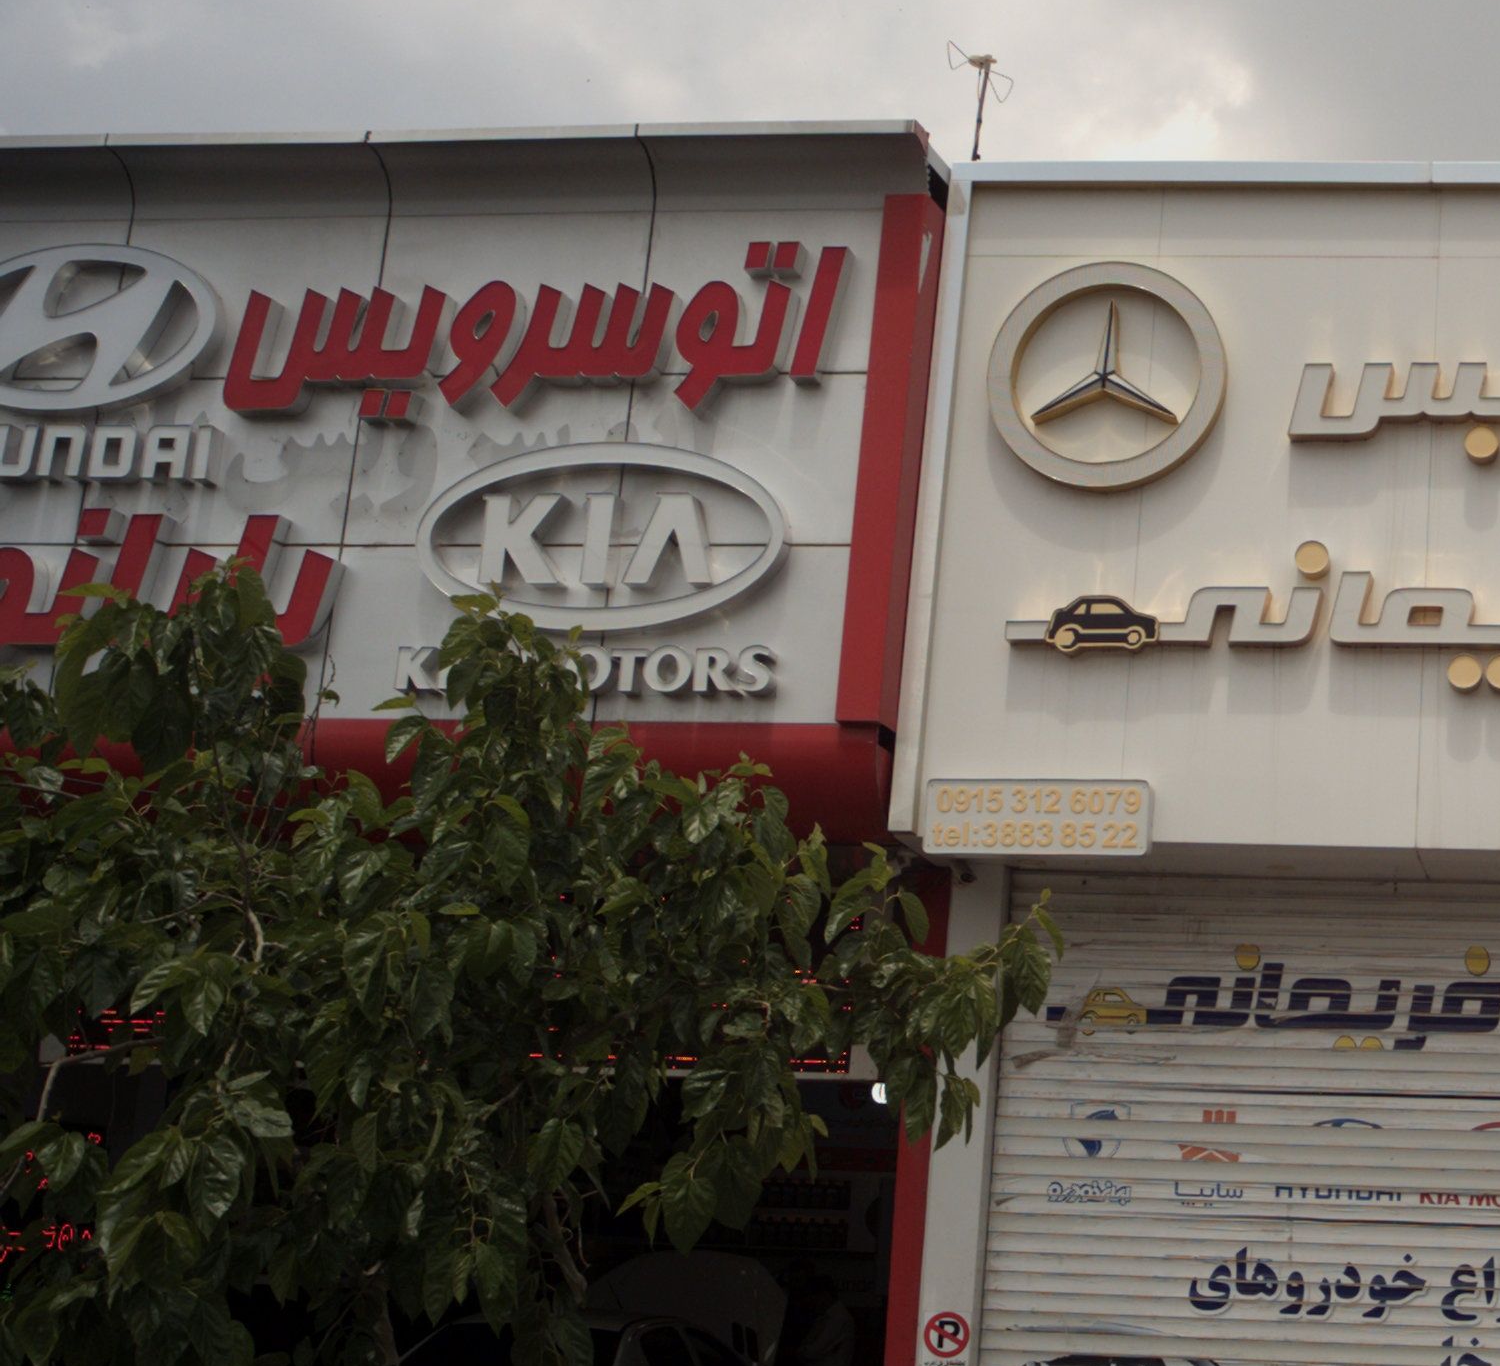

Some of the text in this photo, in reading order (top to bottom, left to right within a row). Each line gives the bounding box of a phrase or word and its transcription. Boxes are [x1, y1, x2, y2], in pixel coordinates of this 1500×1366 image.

[477, 491, 714, 588] KIA
[508, 644, 778, 693] OTORS
[936, 787, 1142, 815] 0915 312 6079
[1175, 1181, 1243, 1207] سایپا
[1188, 1246, 1428, 1319] خودروهای
